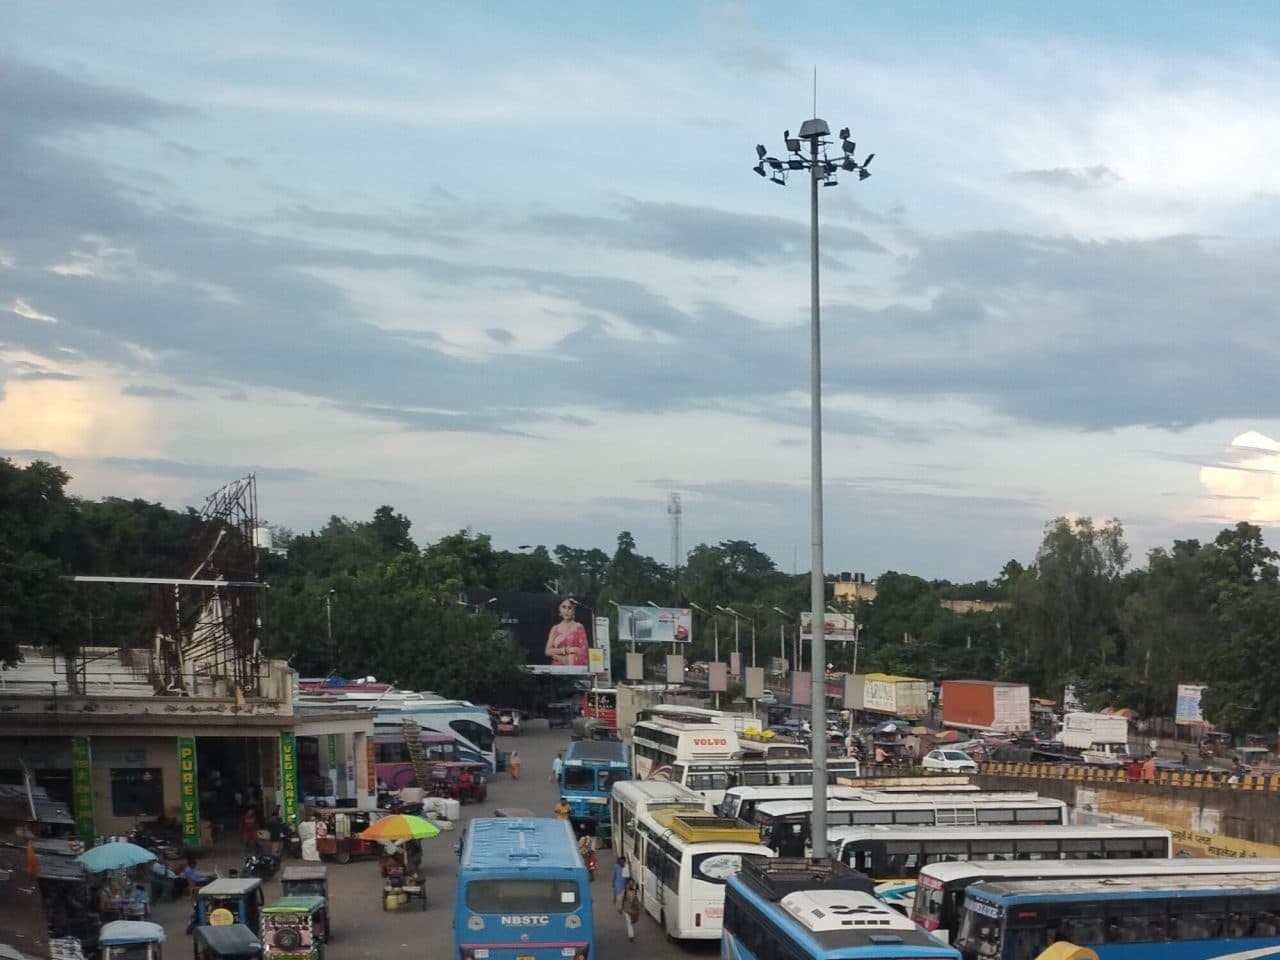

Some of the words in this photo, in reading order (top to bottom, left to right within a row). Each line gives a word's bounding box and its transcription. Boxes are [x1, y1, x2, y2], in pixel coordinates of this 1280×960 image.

[693, 738, 727, 746] VOLVO
[283, 745, 293, 770] VEG
[181, 748, 193, 796] PURE
[184, 801, 196, 835] VEG
[501, 915, 550, 925] NBSTC
